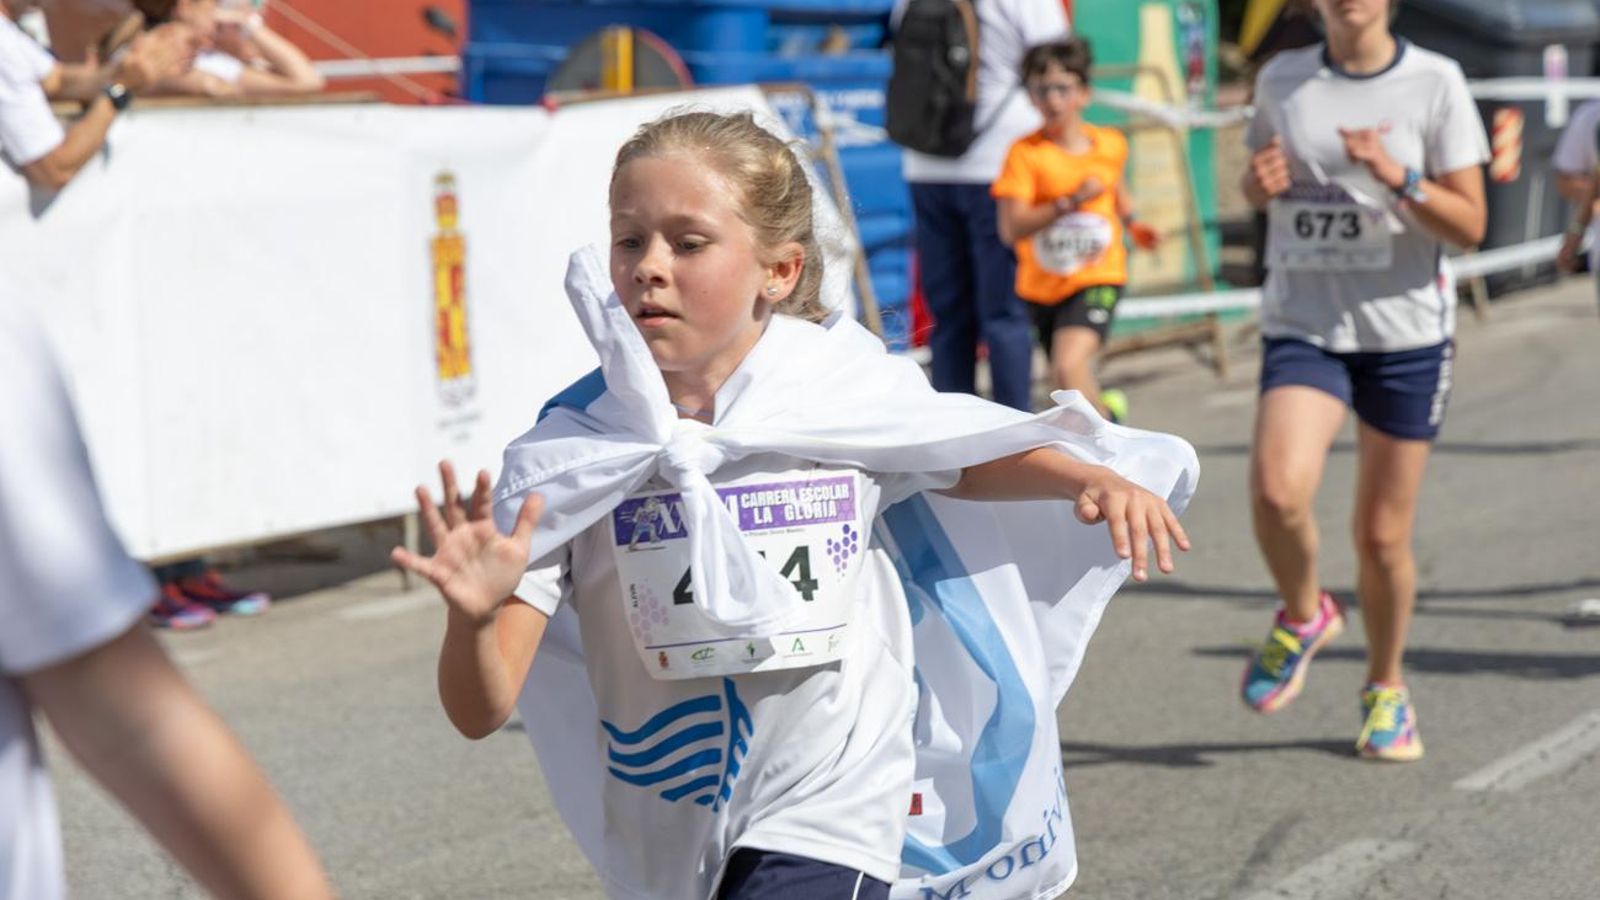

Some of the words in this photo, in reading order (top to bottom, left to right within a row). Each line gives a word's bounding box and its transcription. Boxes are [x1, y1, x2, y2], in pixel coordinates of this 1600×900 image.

[1294, 210, 1361, 239] 673
[741, 488, 797, 508] CARRERA
[801, 483, 850, 501] ESCOLAR
[753, 506, 773, 524] LA
[784, 500, 837, 521] GLORIA
